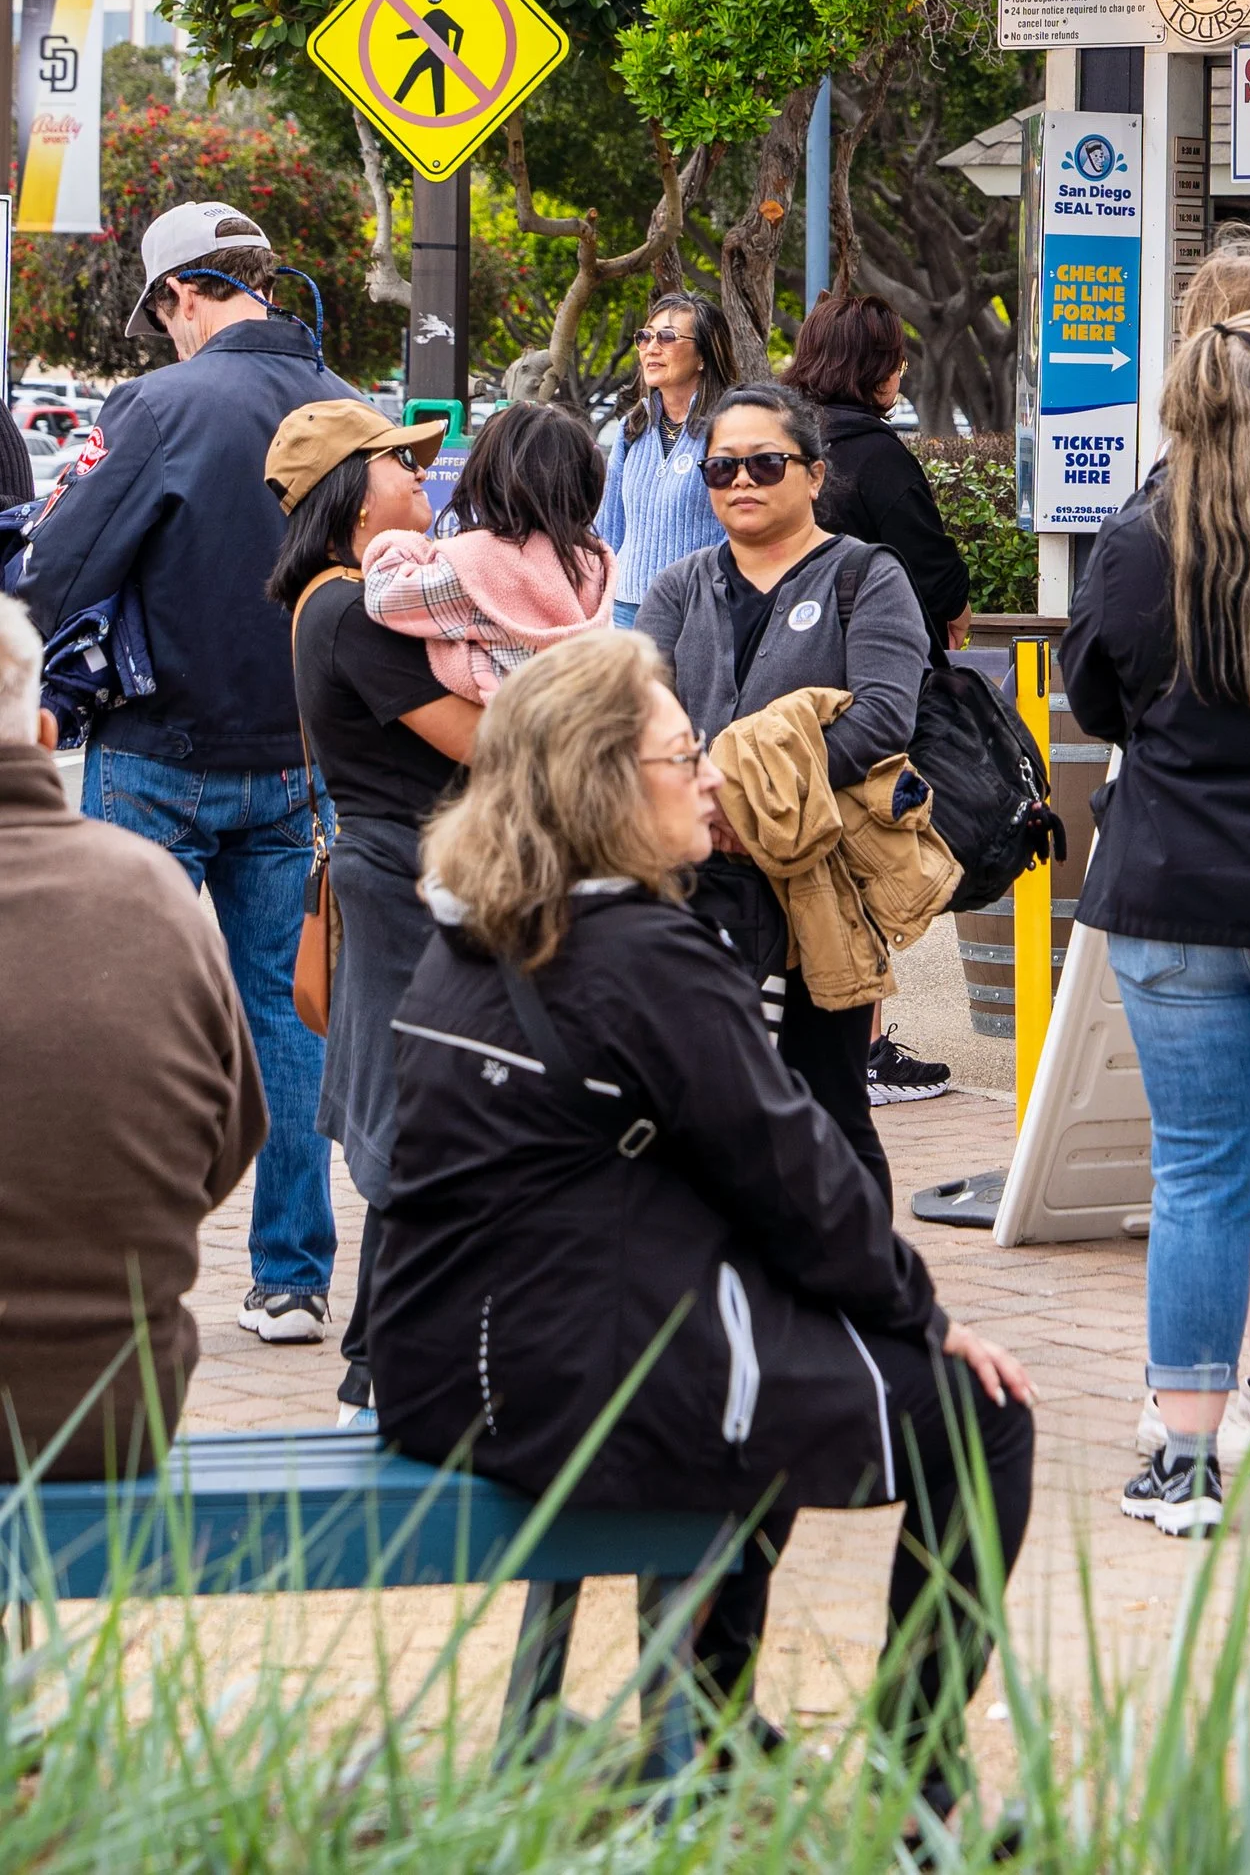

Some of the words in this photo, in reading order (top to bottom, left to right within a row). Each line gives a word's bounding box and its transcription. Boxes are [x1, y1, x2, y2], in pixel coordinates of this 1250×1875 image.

[1011, 7, 1021, 16] 24
[1022, 6, 1039, 15] hour
[1041, 6, 1065, 15] notice
[1066, 5, 1097, 15] required
[1099, 4, 1107, 13] to
[1137, 4, 1145, 12] or
[1018, 19, 1042, 28] cancel
[1044, 18, 1060, 27] tour
[1169, 0, 1244, 38] TOURS
[1010, 32, 1021, 41] No
[1023, 31, 1049, 41] on-site
[1051, 30, 1079, 40] refunds
[39, 34, 79, 93] SD
[1059, 184, 1087, 198] San
[1089, 185, 1132, 202] Diego
[1054, 202, 1093, 215] SEAL
[1096, 203, 1136, 216] Tours
[1056, 264, 1123, 283] CHECK
[1054, 284, 1076, 301] IN
[1081, 285, 1125, 303] LINE
[1053, 304, 1126, 322] FORMS
[1062, 324, 1116, 342] HERE
[1052, 436, 1125, 451] TICKETS
[432, 456, 468, 467] DIFFER
[1065, 453, 1111, 468] SOLD
[1064, 470, 1111, 484] HERE
[1056, 506, 1119, 514] 619.298.8687
[1051, 515, 1104, 523] SEALTOURS.
